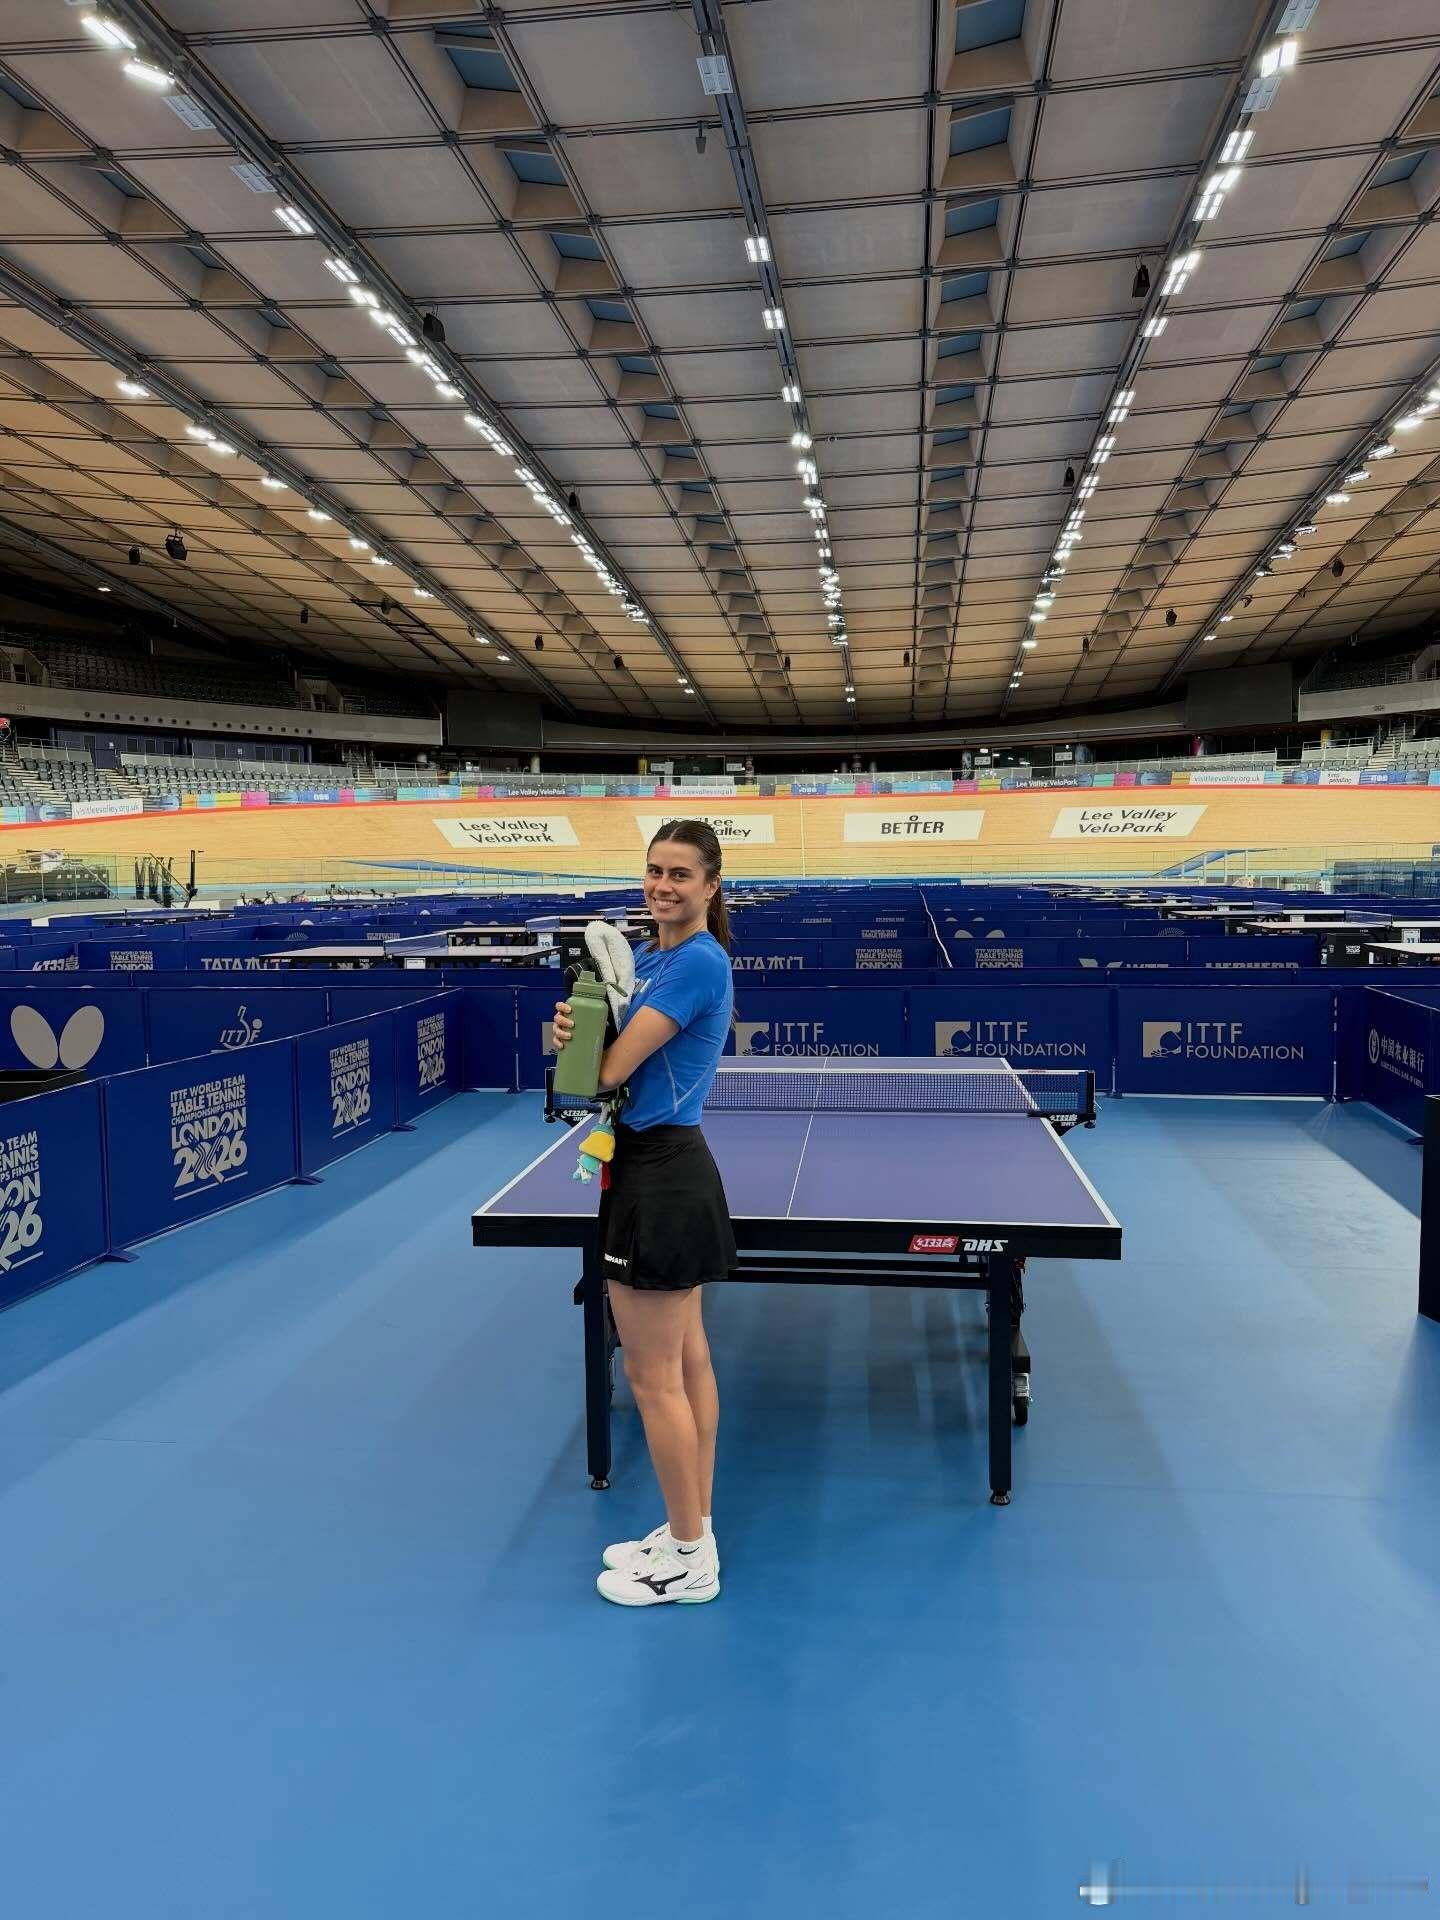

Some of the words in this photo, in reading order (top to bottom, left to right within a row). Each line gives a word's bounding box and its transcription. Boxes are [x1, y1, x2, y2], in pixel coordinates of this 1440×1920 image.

[1080, 810, 1113, 821] Lee
[1121, 808, 1178, 822] Valley
[459, 821, 491, 832] Lee
[493, 820, 549, 834] Valley
[713, 827, 752, 838] alley
[881, 821, 944, 835] BETTER
[1078, 822, 1166, 834] VeloPark
[469, 832, 554, 845] VeloPark
[219, 1029, 261, 1044] ITTF
[774, 1022, 824, 1043] ITTF
[976, 1021, 1028, 1042] ITTF
[1186, 1022, 1243, 1044] ITTF
[330, 1053, 349, 1071] TABLE
[349, 1046, 370, 1065] TENNIS
[417, 1035, 445, 1061] LONDON
[774, 1043, 880, 1057] FOUNDATION
[975, 1043, 1087, 1057] FOUNDATION
[1186, 1044, 1305, 1060] FOUNDATION
[418, 1050, 446, 1088] 2026
[170, 1088, 188, 1102] ITTF
[189, 1080, 221, 1098] WORLD
[222, 1074, 246, 1088] TEAM
[331, 1065, 370, 1098] LONDON
[171, 1094, 206, 1117] TABLE
[206, 1084, 246, 1107] TENNIS
[332, 1083, 371, 1129] 2026
[171, 1103, 224, 1126] CHAMPIONSHIPS
[225, 1098, 247, 1111] FINALS
[171, 1106, 247, 1150] LONDON
[6, 1131, 38, 1152] TEAM
[0, 1143, 39, 1172] NNIS
[173, 1129, 248, 1188] 2026
[11, 1160, 40, 1179] FINALS
[961, 1238, 1009, 1252] DHS
